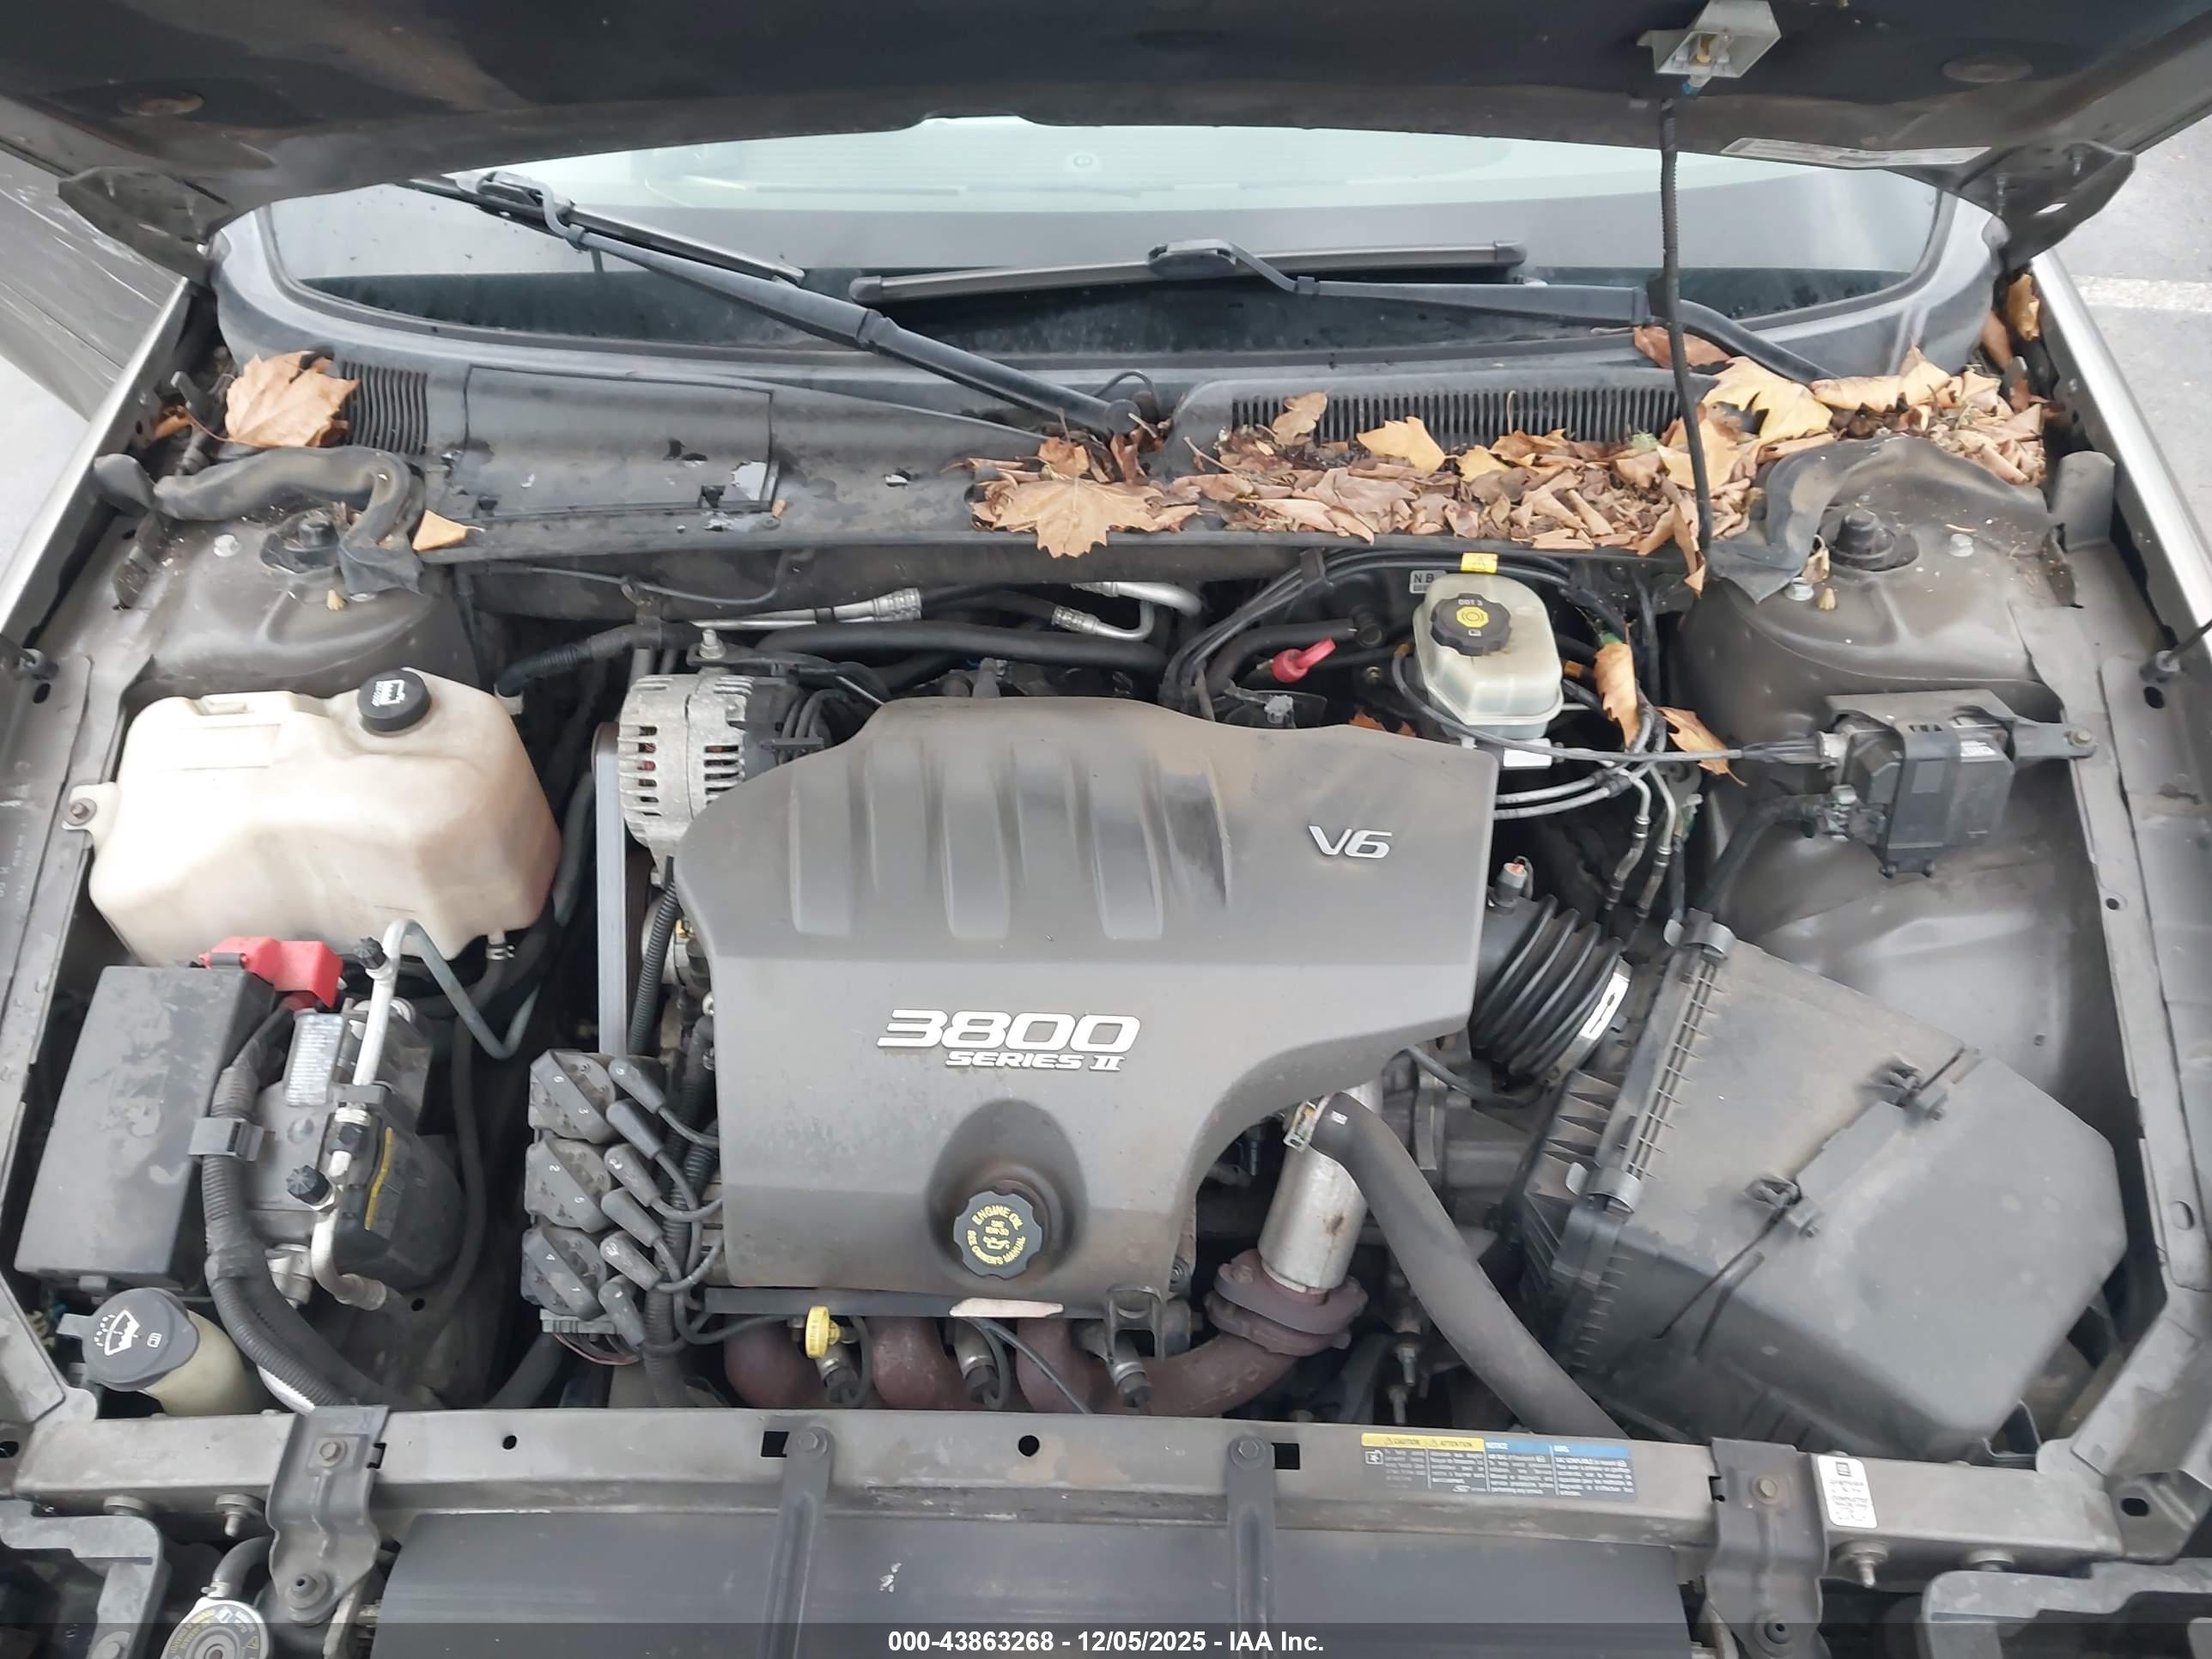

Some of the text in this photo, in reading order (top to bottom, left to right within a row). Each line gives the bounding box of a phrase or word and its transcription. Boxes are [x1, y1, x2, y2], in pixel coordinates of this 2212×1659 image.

[1308, 825, 1393, 859] V6
[877, 1009, 1140, 1053] 3800
[945, 1050, 1127, 1071] SERIES II
[971, 1205, 1023, 1231] ENGINE OIL
[967, 1230, 1026, 1265] SEE OWNER'S MANUAL
